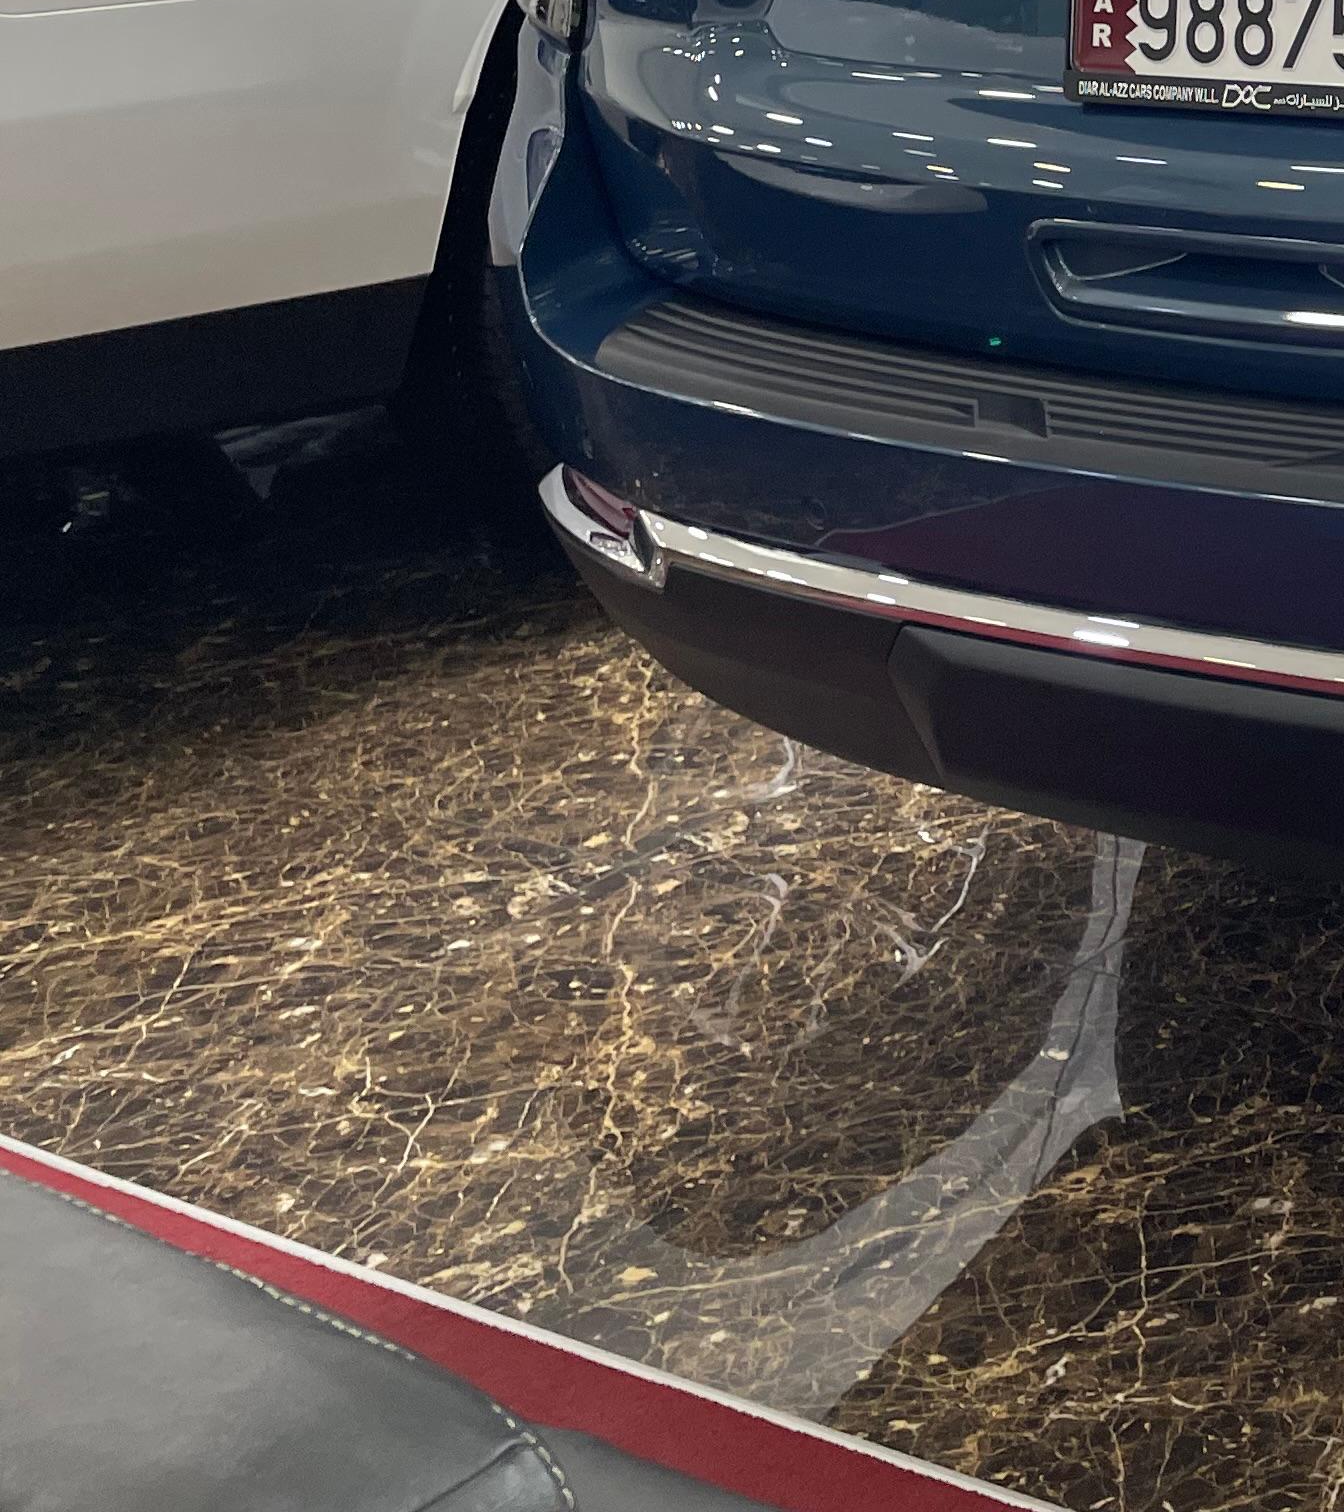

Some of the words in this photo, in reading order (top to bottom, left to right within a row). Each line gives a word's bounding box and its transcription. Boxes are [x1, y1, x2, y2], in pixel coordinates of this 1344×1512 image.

[1078, 80, 1099, 96] DIAR
[1100, 82, 1128, 98] AL-AZZ
[1129, 84, 1153, 100] CARS
[1153, 85, 1193, 102] COMPANY
[1286, 94, 1333, 110] للسيارات
